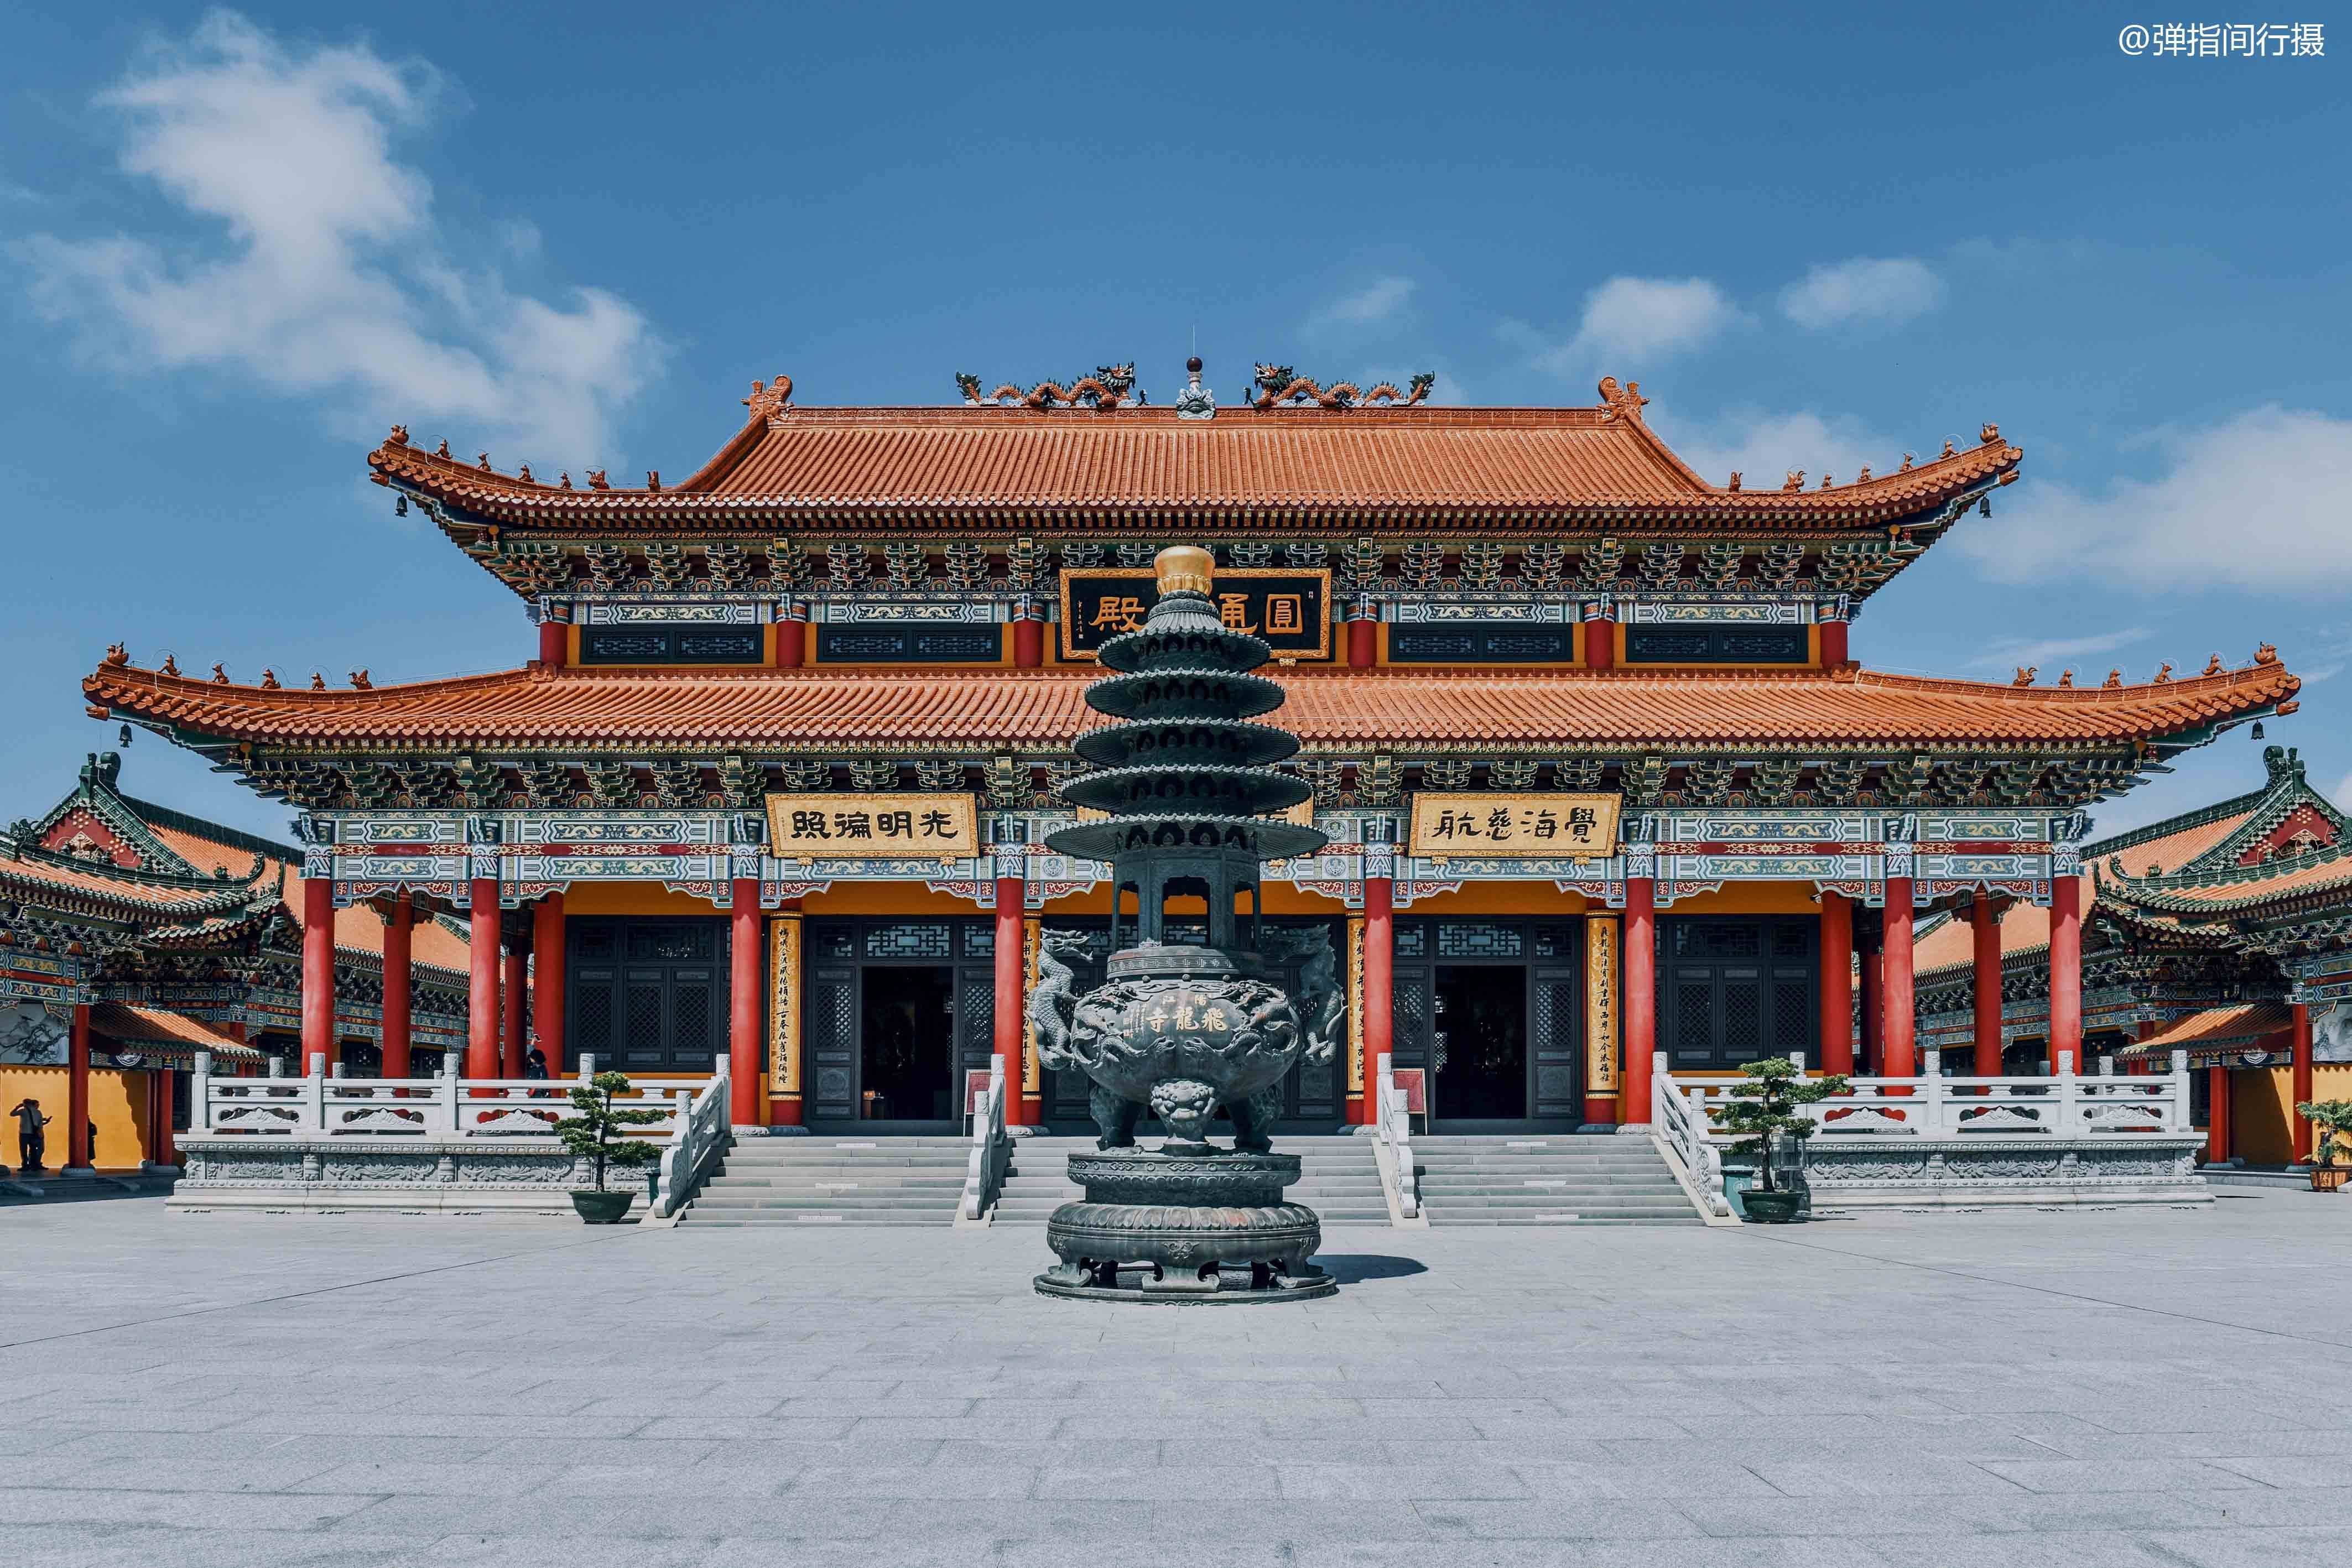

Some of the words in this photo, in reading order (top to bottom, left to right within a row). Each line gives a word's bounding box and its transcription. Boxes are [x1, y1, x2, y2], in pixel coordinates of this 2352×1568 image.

[1432, 807, 1597, 843] 覺海慈航
[1146, 1007, 1227, 1033] 飛龍寺
